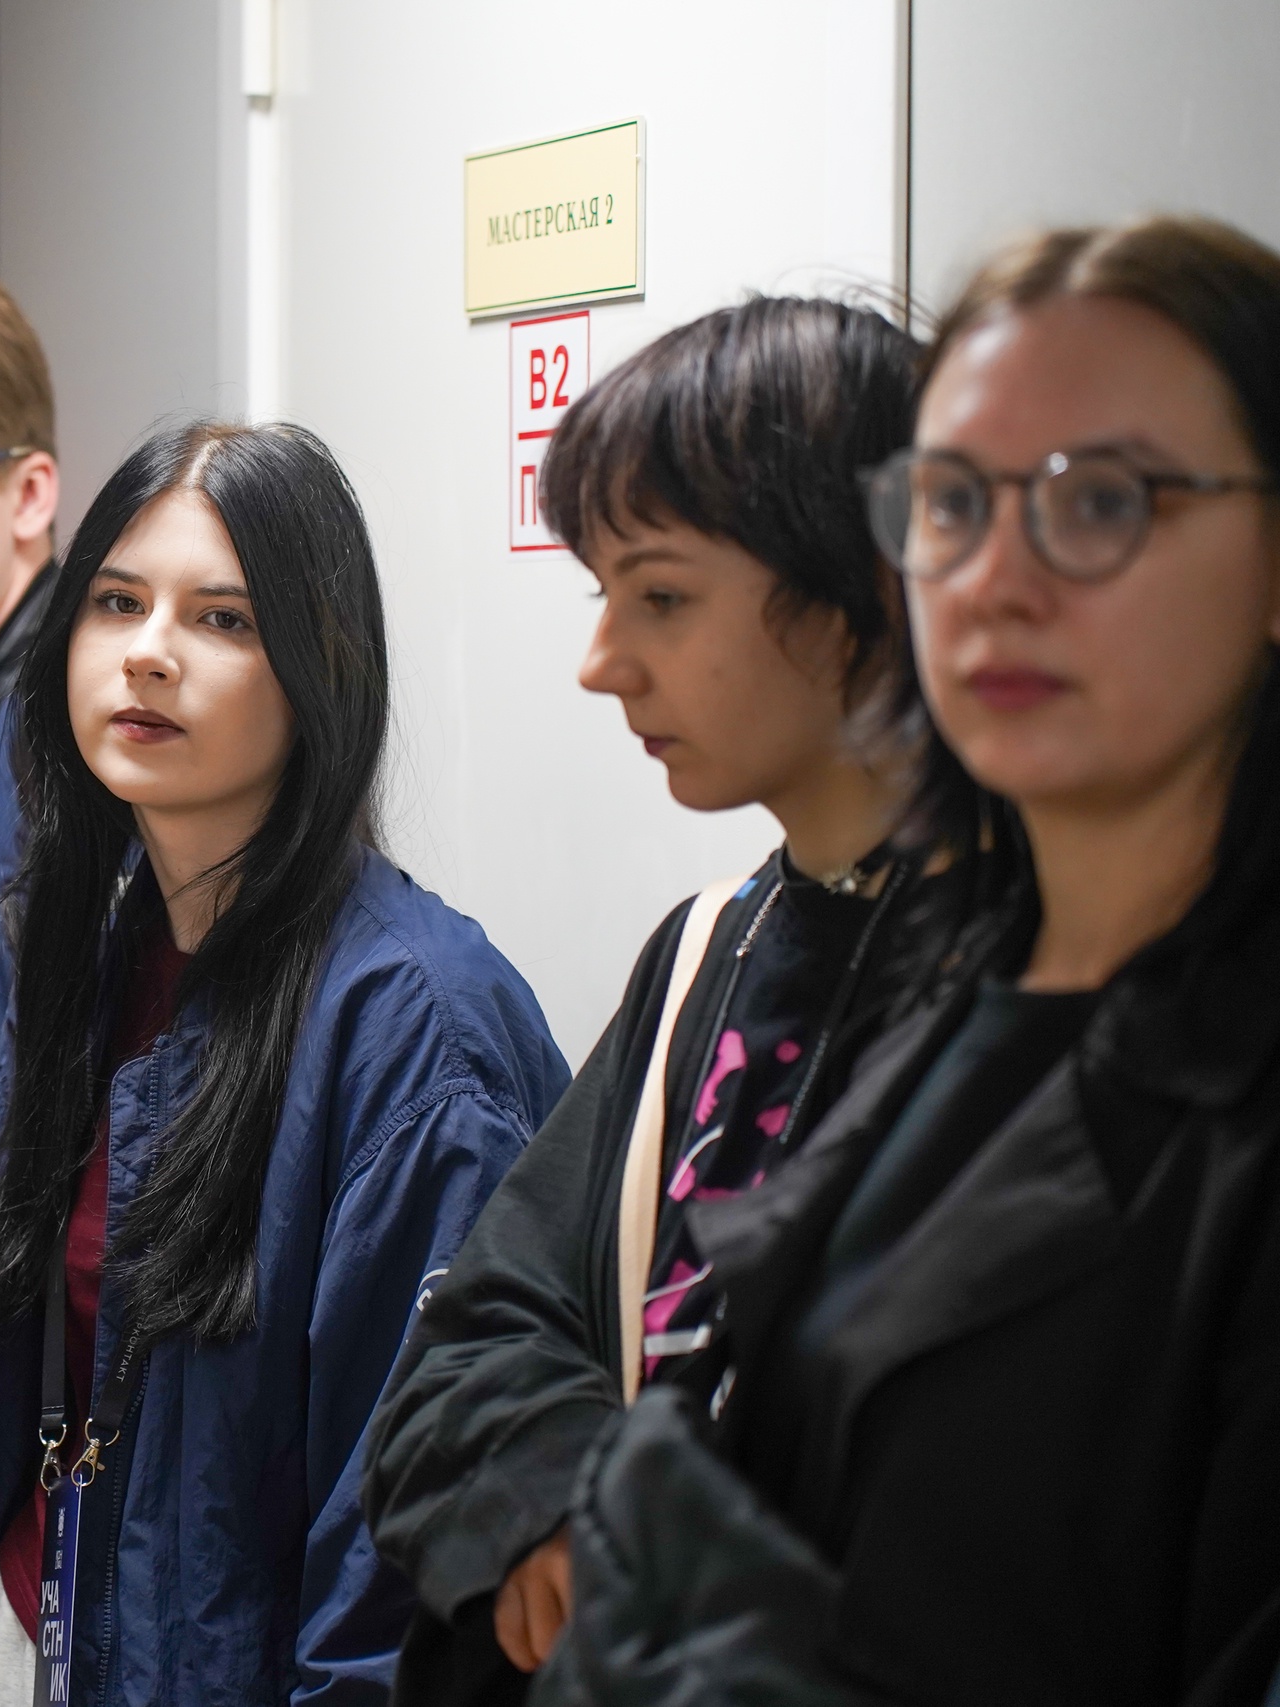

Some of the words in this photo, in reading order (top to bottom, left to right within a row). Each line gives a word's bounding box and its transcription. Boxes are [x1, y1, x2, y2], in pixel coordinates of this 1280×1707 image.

[486, 197, 599, 247] МАСТЕРСКАЯ
[605, 194, 614, 225] 2
[530, 345, 570, 410] В2
[40, 1580, 59, 1614] УЧА
[42, 1620, 64, 1657] СТН
[49, 1663, 67, 1701] ИК
